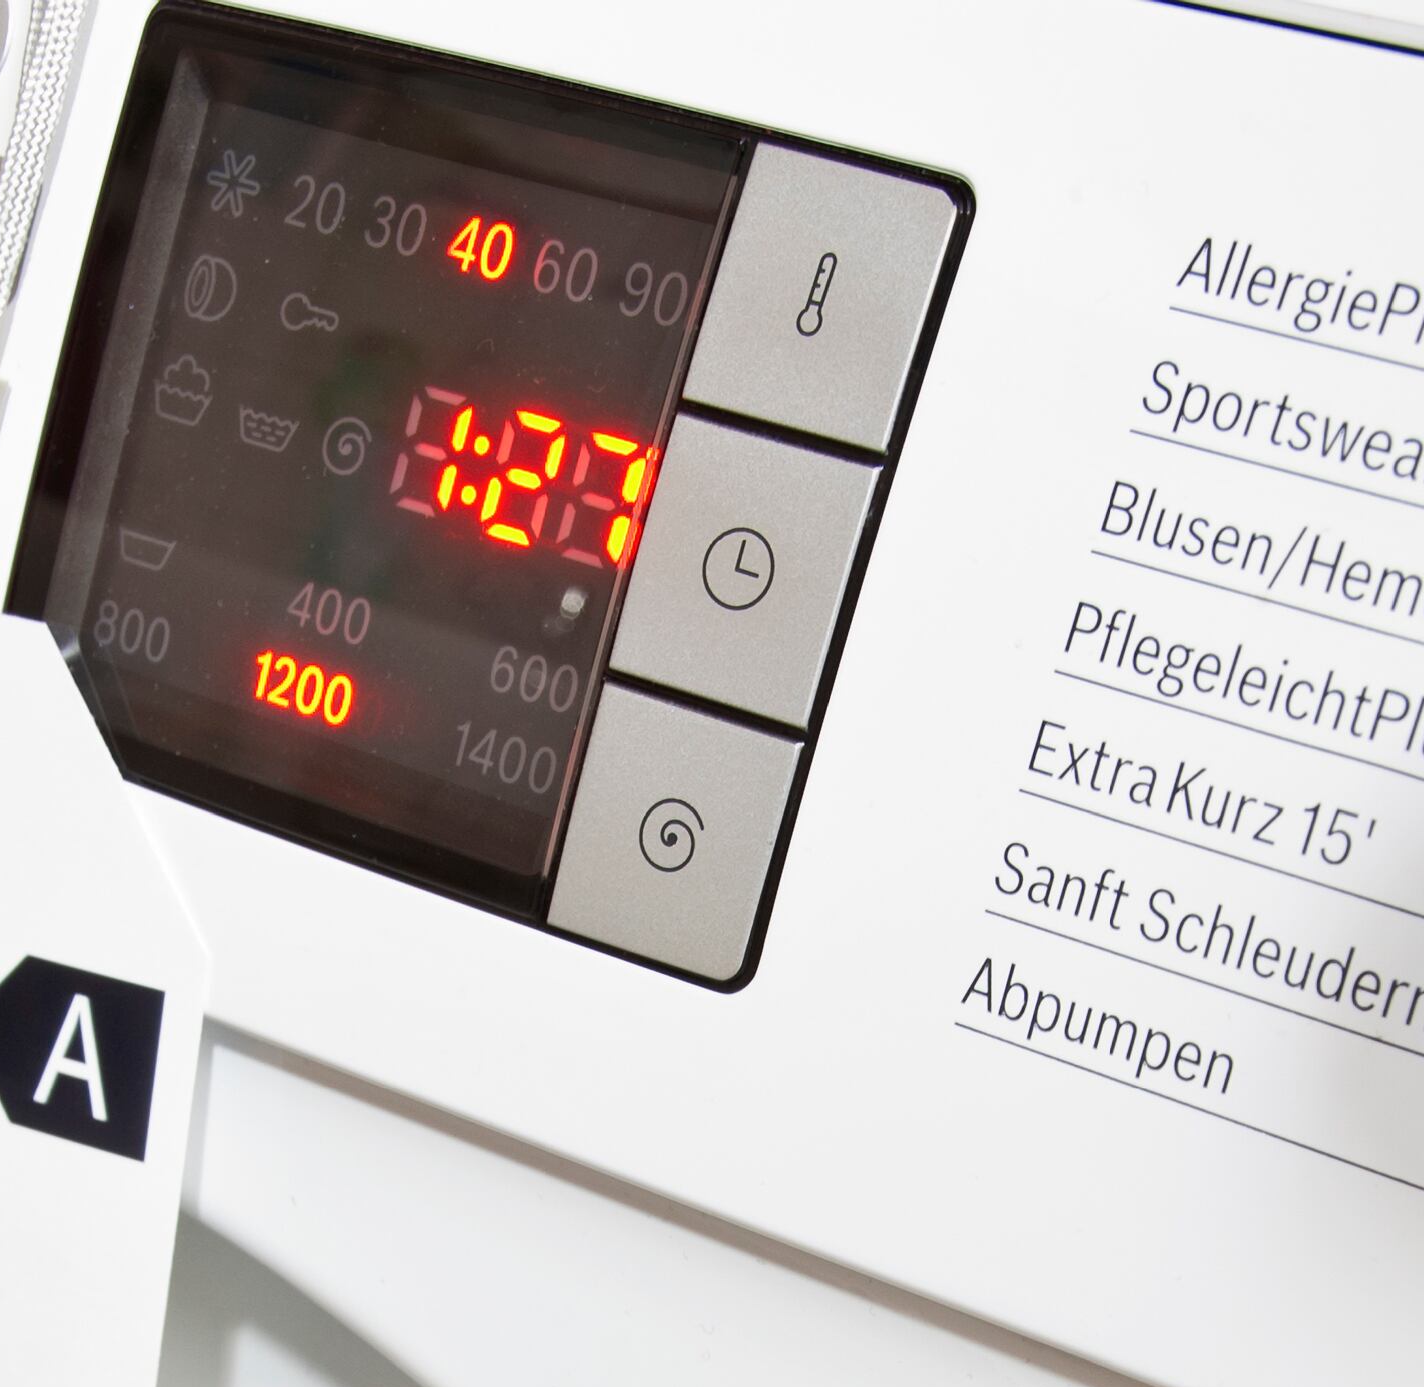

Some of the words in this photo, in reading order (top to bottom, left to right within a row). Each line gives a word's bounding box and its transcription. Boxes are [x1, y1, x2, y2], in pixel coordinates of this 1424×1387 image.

[284, 174, 346, 235] 20
[364, 196, 427, 257] 30
[448, 215, 515, 281] 40
[533, 239, 598, 303] 60
[619, 261, 688, 327] 90
[436, 404, 650, 565] 1:27
[93, 599, 171, 663] 800
[286, 581, 371, 645] 400
[255, 649, 354, 725] 1200
[489, 645, 579, 713] 600
[455, 719, 558, 795] 1400
[1301, 802, 1378, 867] 15'
[994, 842, 1130, 931] Sanft
[32, 993, 108, 1122] A
[961, 957, 1235, 1095] Abpumpen
